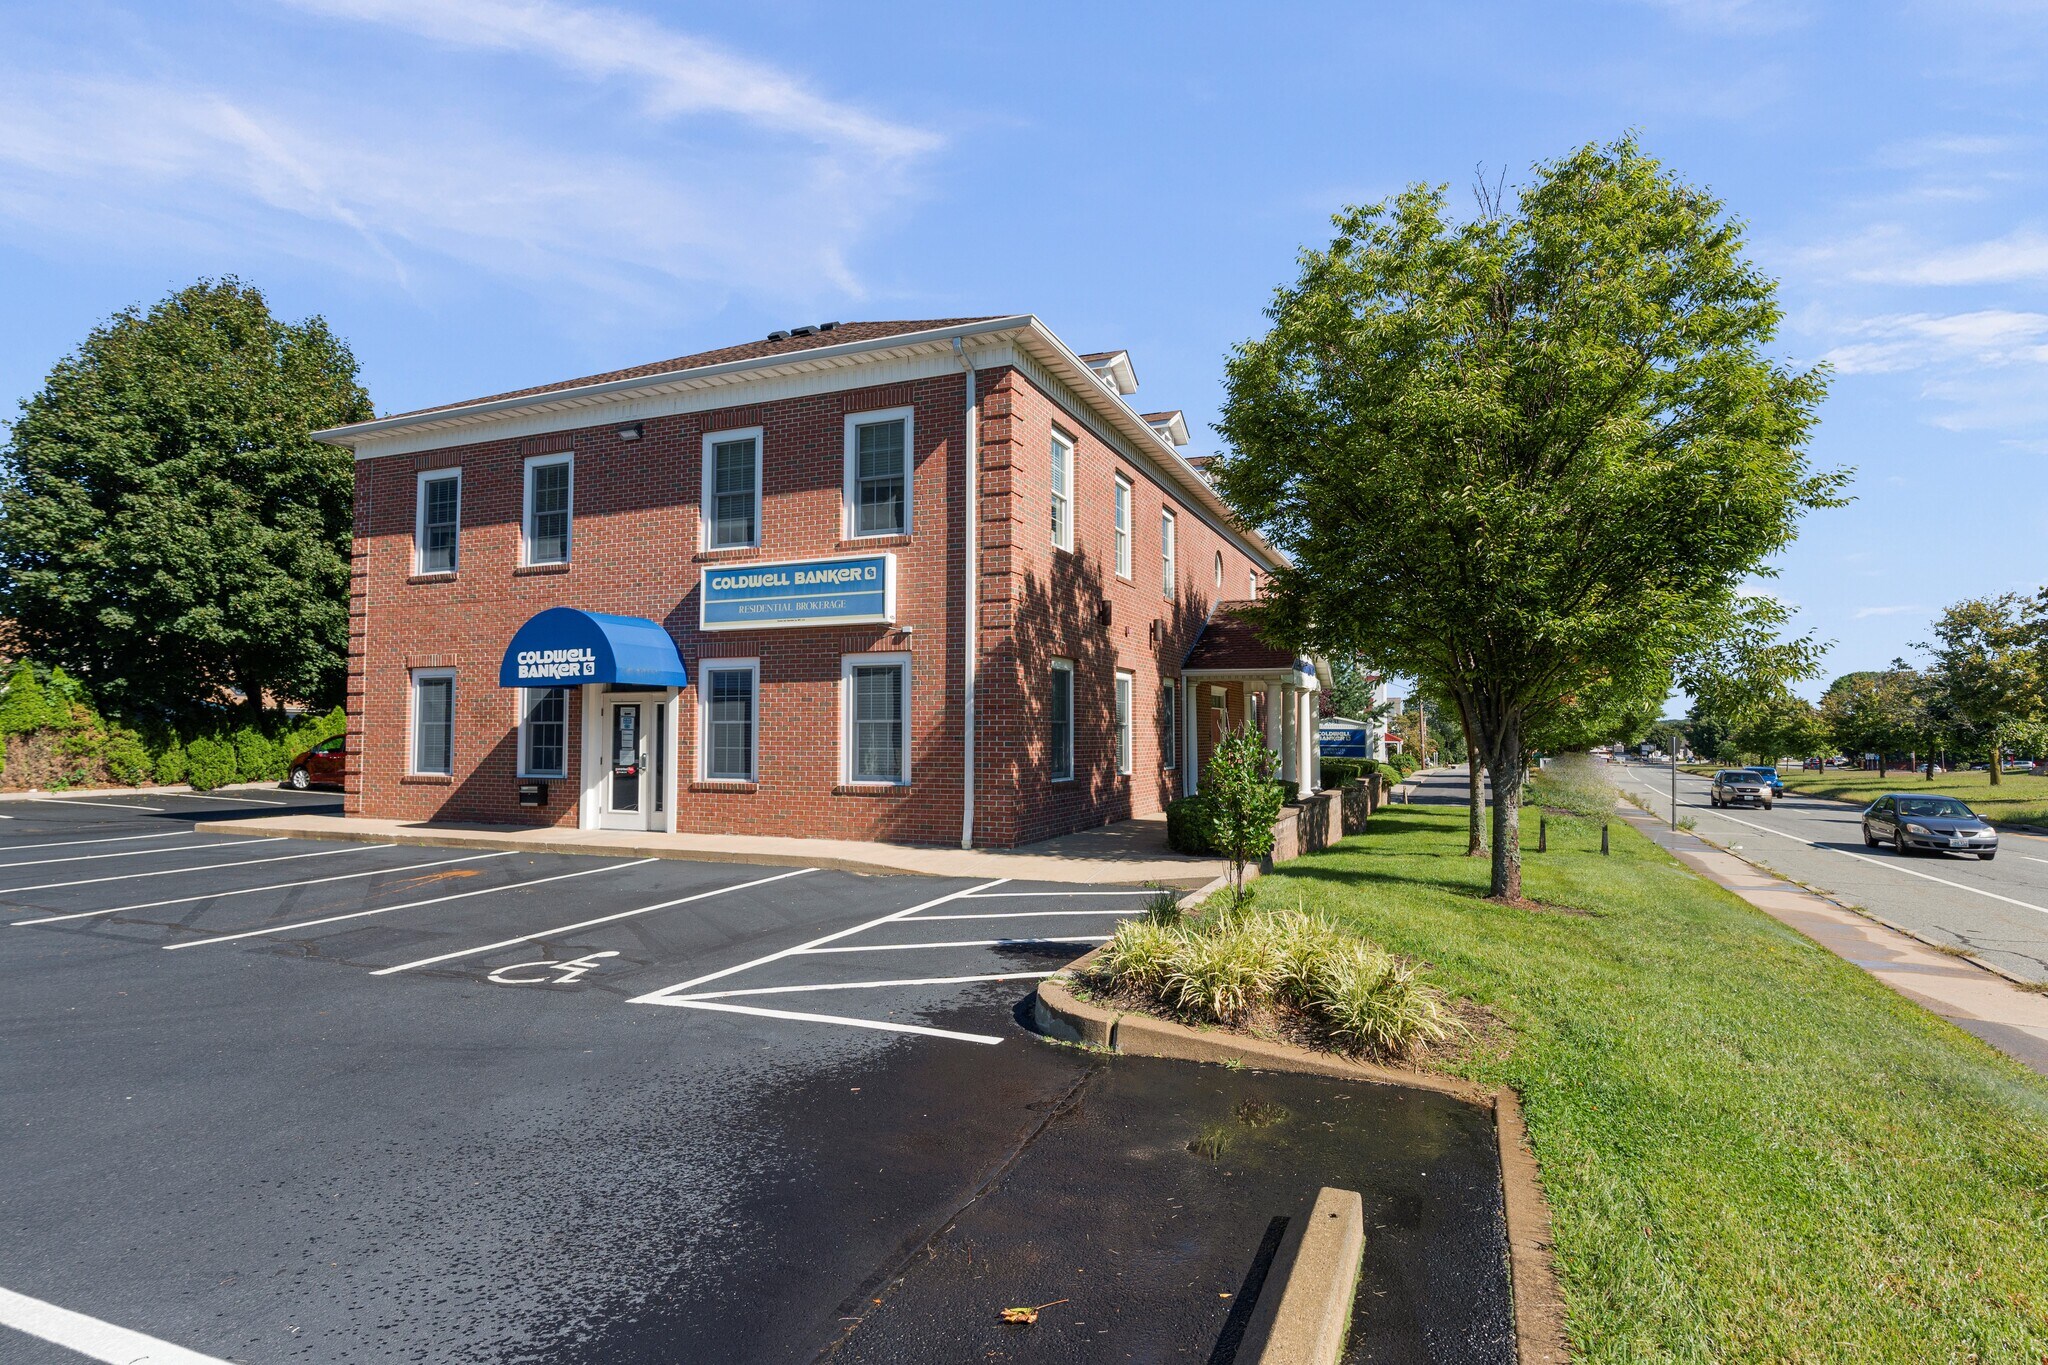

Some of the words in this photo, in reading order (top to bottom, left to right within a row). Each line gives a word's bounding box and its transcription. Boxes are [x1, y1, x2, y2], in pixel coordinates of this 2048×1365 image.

[711, 572, 791, 591] COLDWELL
[794, 567, 862, 585] BANKER
[738, 602, 792, 614] RESIDENTIAL
[795, 600, 847, 611] BROKERAGE
[517, 648, 596, 664] COLDWELL
[518, 662, 580, 679] BANKER
